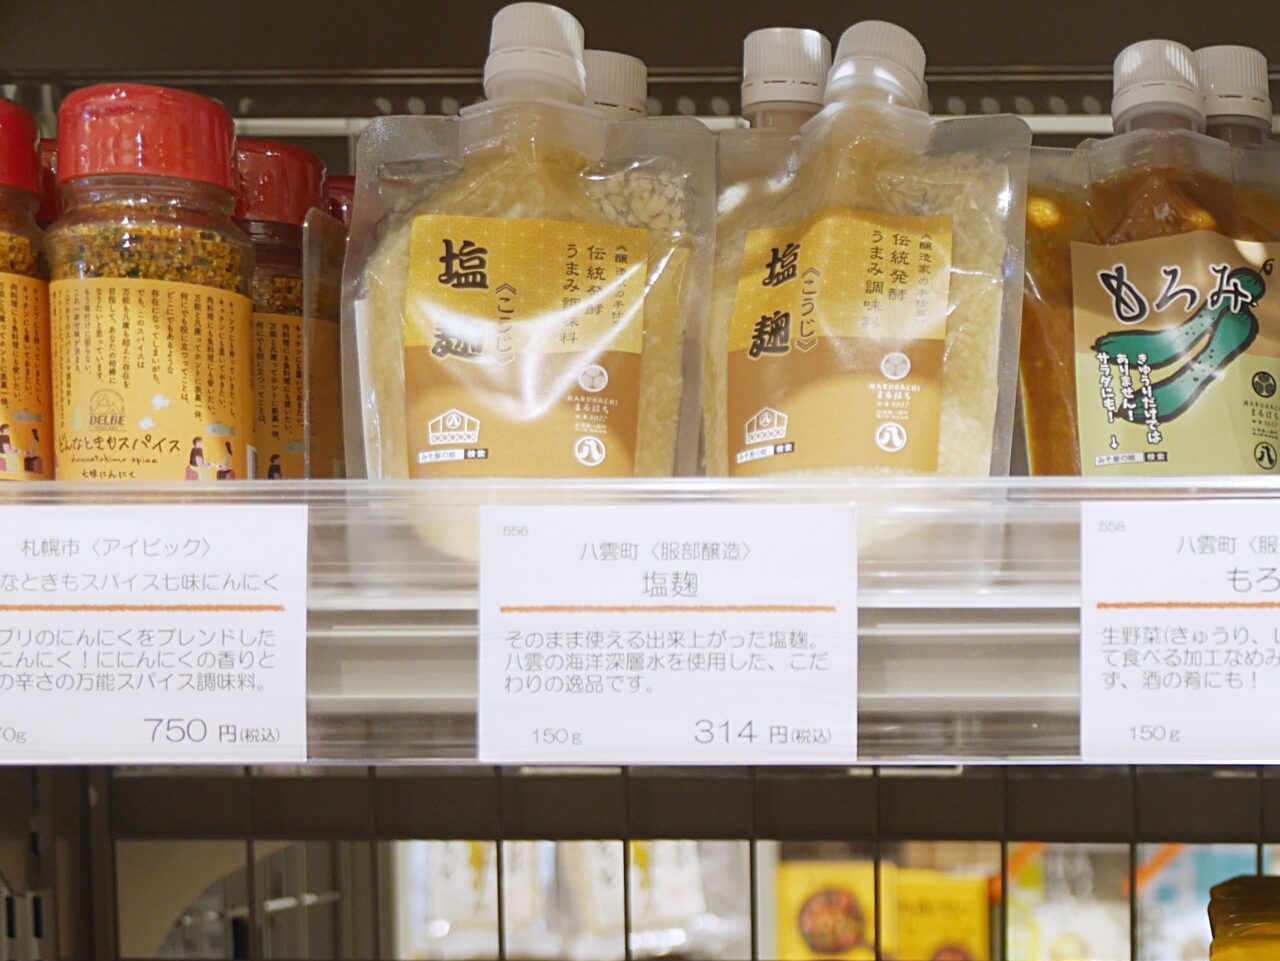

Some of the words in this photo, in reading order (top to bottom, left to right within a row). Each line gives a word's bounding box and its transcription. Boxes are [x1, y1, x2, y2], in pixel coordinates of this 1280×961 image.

[1099, 263, 1252, 324] もろみ
[503, 526, 529, 537] 556
[504, 675, 653, 694] わりの逸品です。
[144, 718, 208, 742] 750
[694, 719, 758, 744] 314
